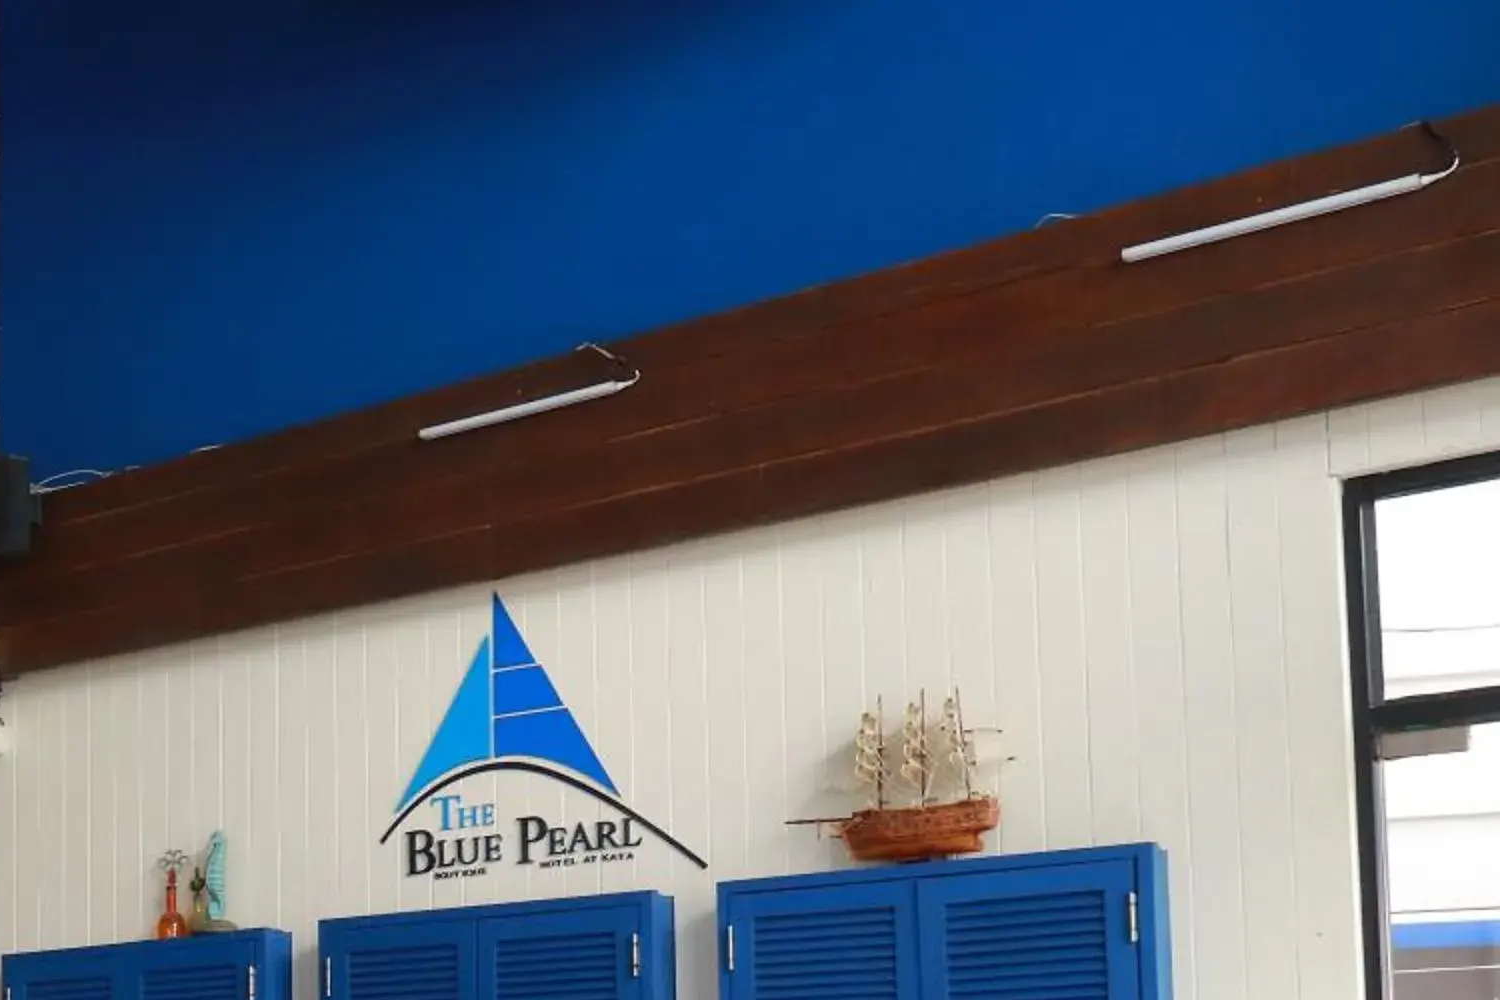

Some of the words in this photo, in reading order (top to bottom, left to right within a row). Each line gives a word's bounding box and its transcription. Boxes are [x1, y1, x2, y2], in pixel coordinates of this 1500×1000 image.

[430, 796, 495, 831] THE
[406, 830, 502, 876] BLUE
[516, 816, 642, 865] PEARL
[601, 853, 634, 862] KATA
